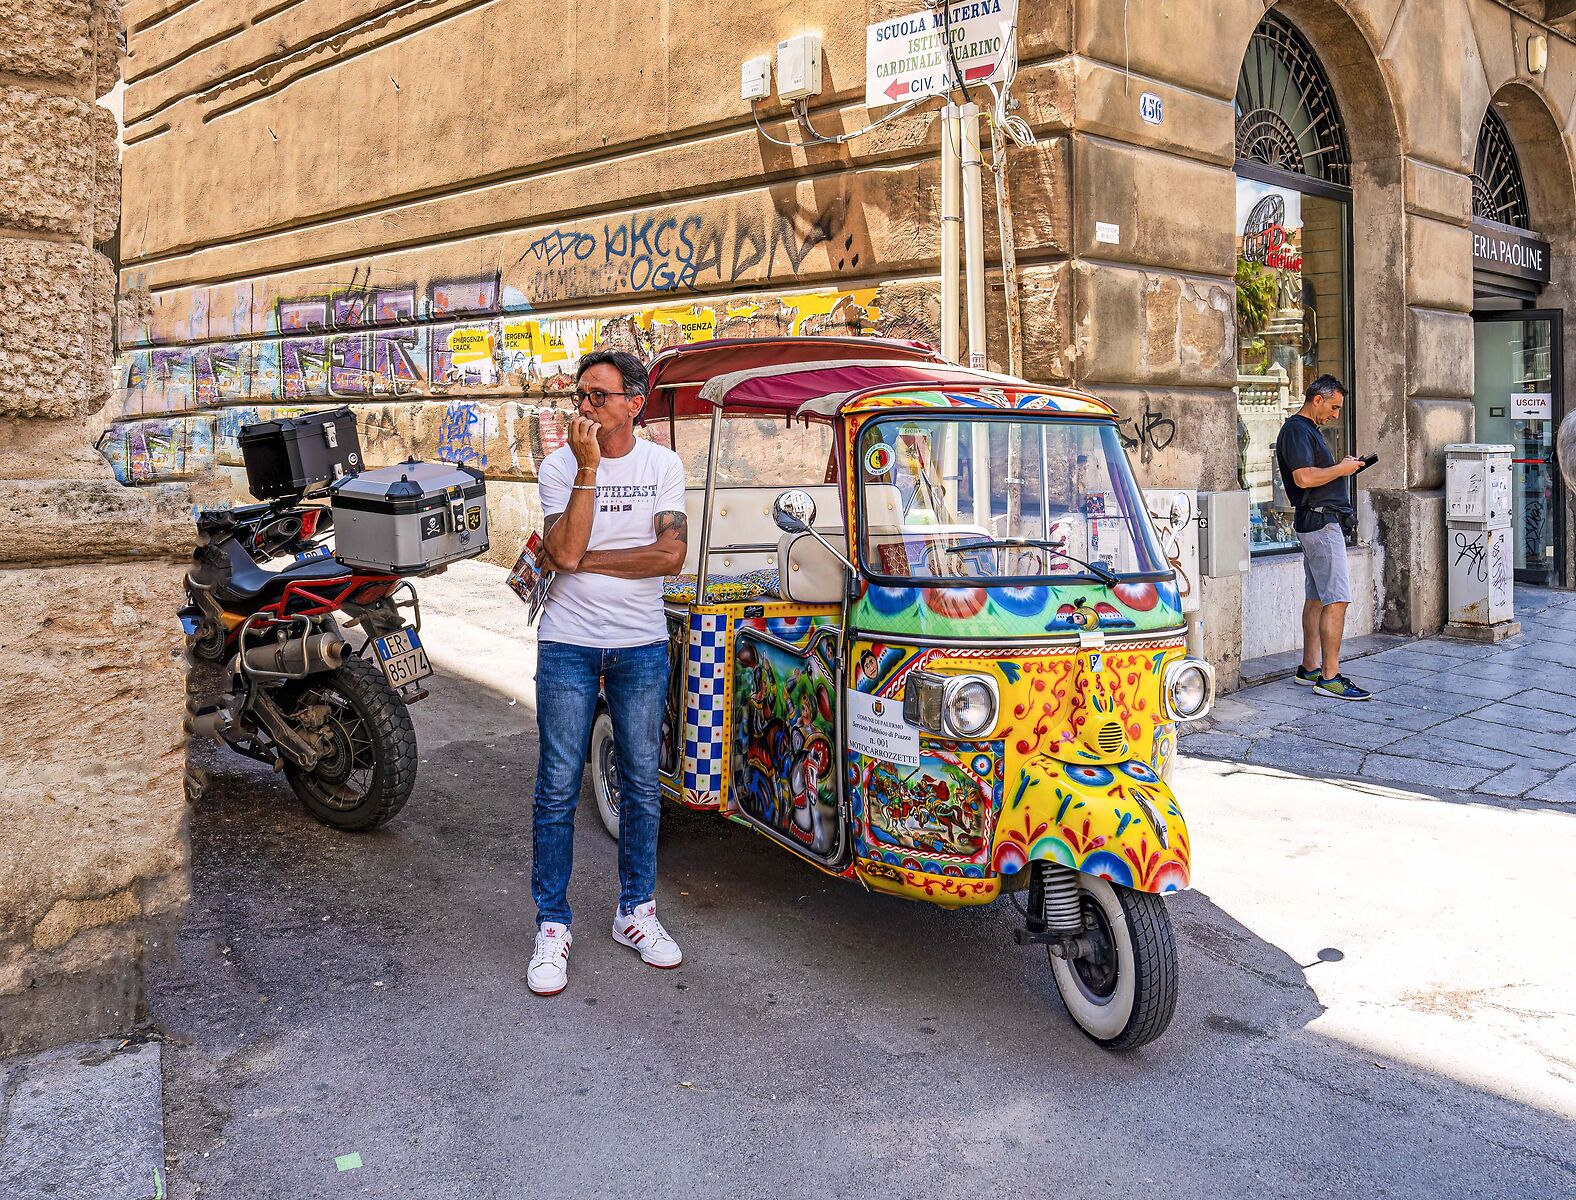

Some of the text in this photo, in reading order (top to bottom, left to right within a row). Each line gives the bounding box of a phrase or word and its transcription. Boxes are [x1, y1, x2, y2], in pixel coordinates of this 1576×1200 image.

[876, 17, 926, 42] SCUOLA
[908, 27, 965, 54] ISTITUTO
[876, 50, 941, 79] CARDINALE
[911, 76, 934, 93] CIV.
[1141, 96, 1162, 121] 456
[1472, 234, 1543, 271] ERIA PAOLINE
[1516, 399, 1547, 407] USCITA
[385, 634, 406, 656] ER
[388, 651, 428, 682] 85174
[856, 713, 874, 724] COMUNE
[880, 720, 904, 730] PALERMO
[876, 738, 889, 748] 001
[894, 732, 912, 741] Piazza
[849, 739, 918, 764] MOTOCARROZZETTE
